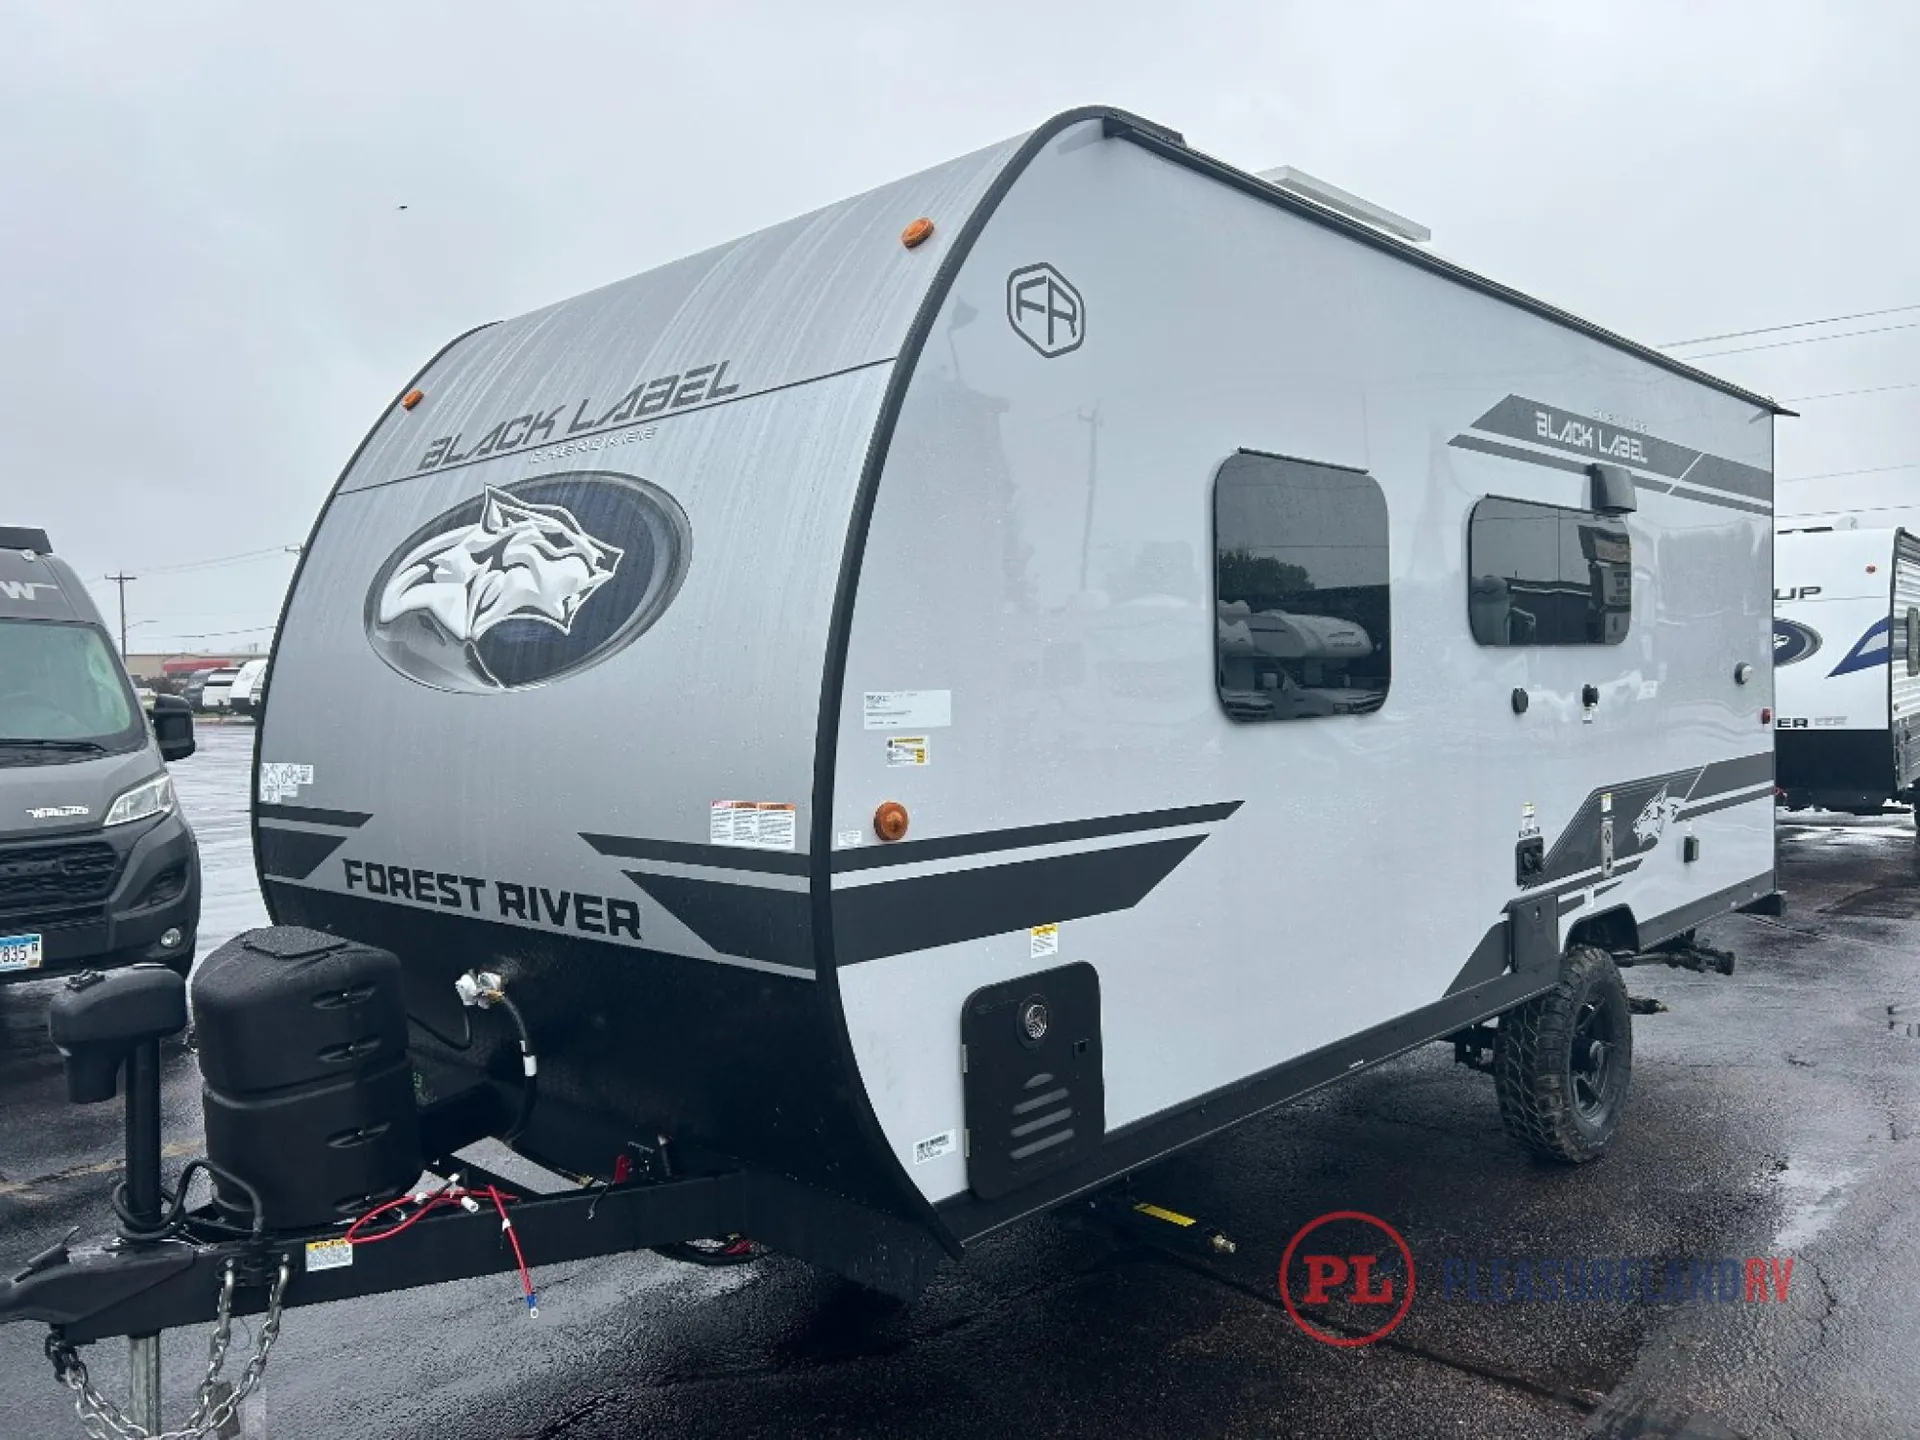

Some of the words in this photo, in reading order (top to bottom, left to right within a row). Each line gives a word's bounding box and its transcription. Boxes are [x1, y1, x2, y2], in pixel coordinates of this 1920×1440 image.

[417, 404, 566, 471] BLACK
[567, 360, 740, 433] LABEL
[1536, 410, 1593, 449] BLACK
[1598, 429, 1649, 464] LABEL
[342, 858, 487, 912] FOREST
[494, 880, 642, 940] RIVER
